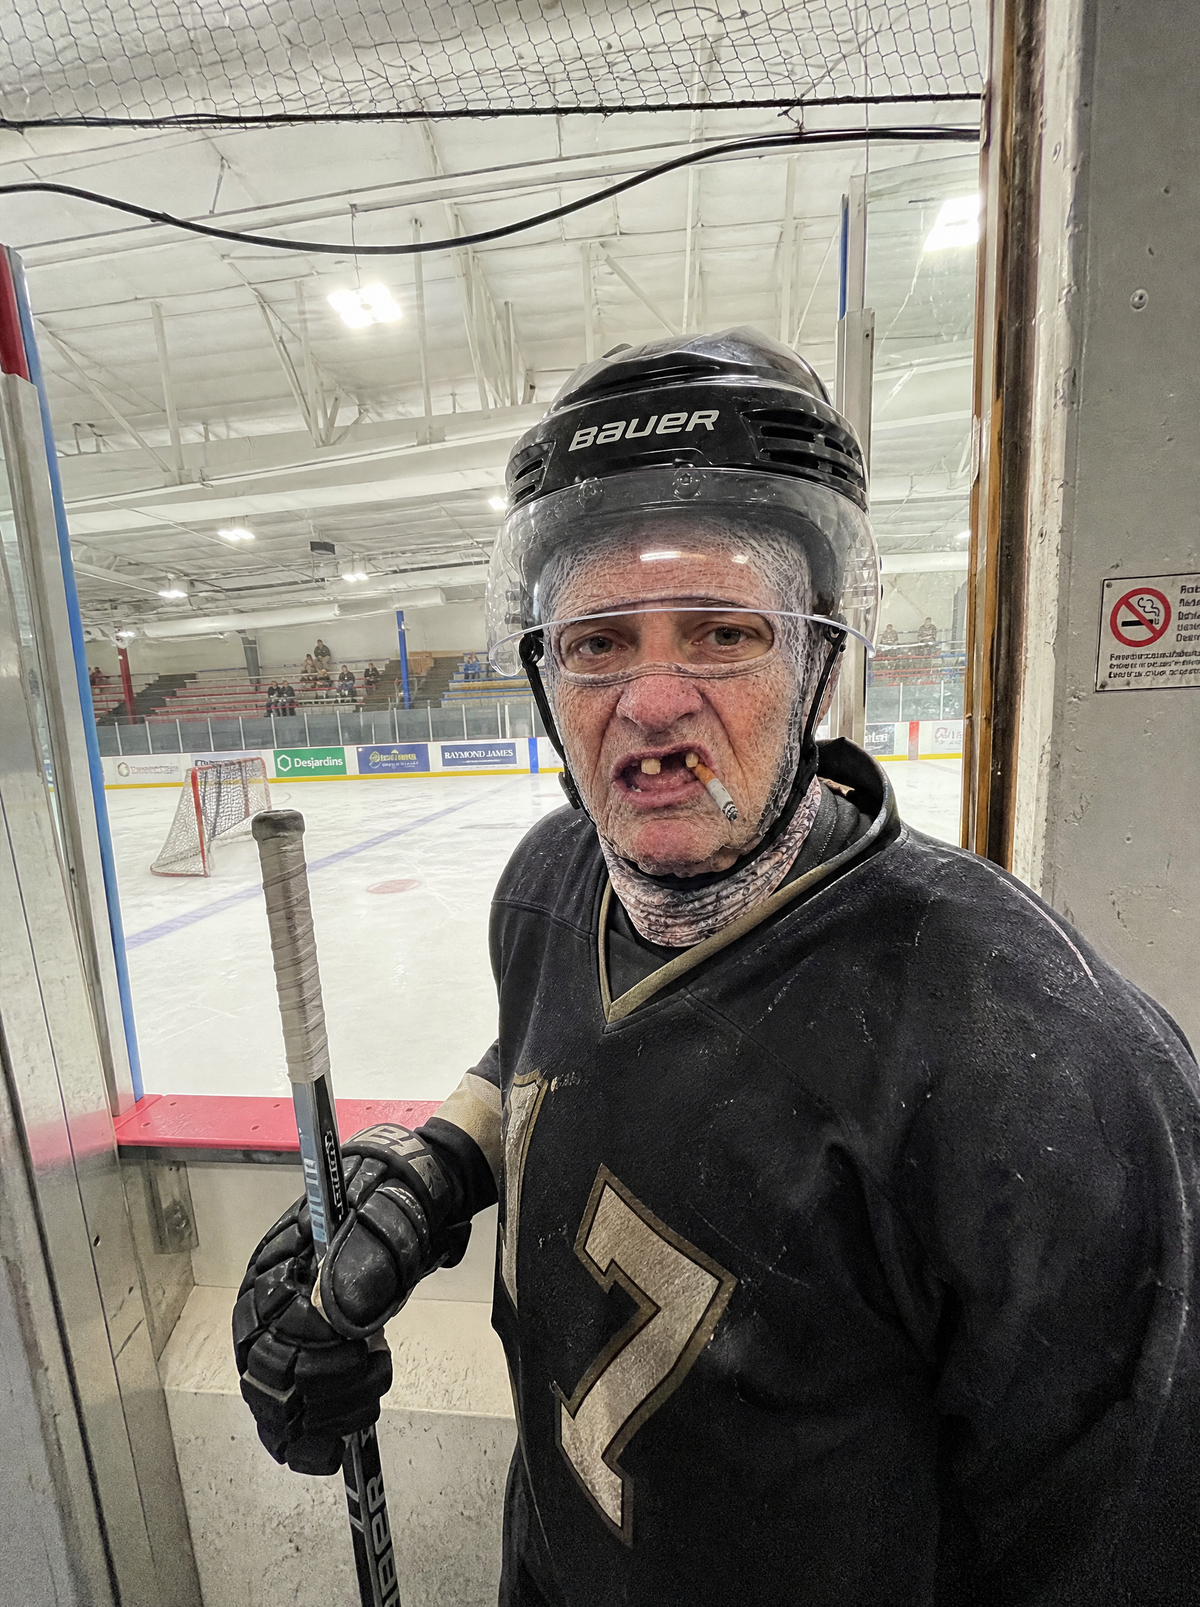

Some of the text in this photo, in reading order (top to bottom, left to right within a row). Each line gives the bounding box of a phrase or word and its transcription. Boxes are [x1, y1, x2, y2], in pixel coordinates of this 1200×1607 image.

[444, 749, 513, 759] RAYMOND JAMES
[294, 756, 343, 769] Desjardins
